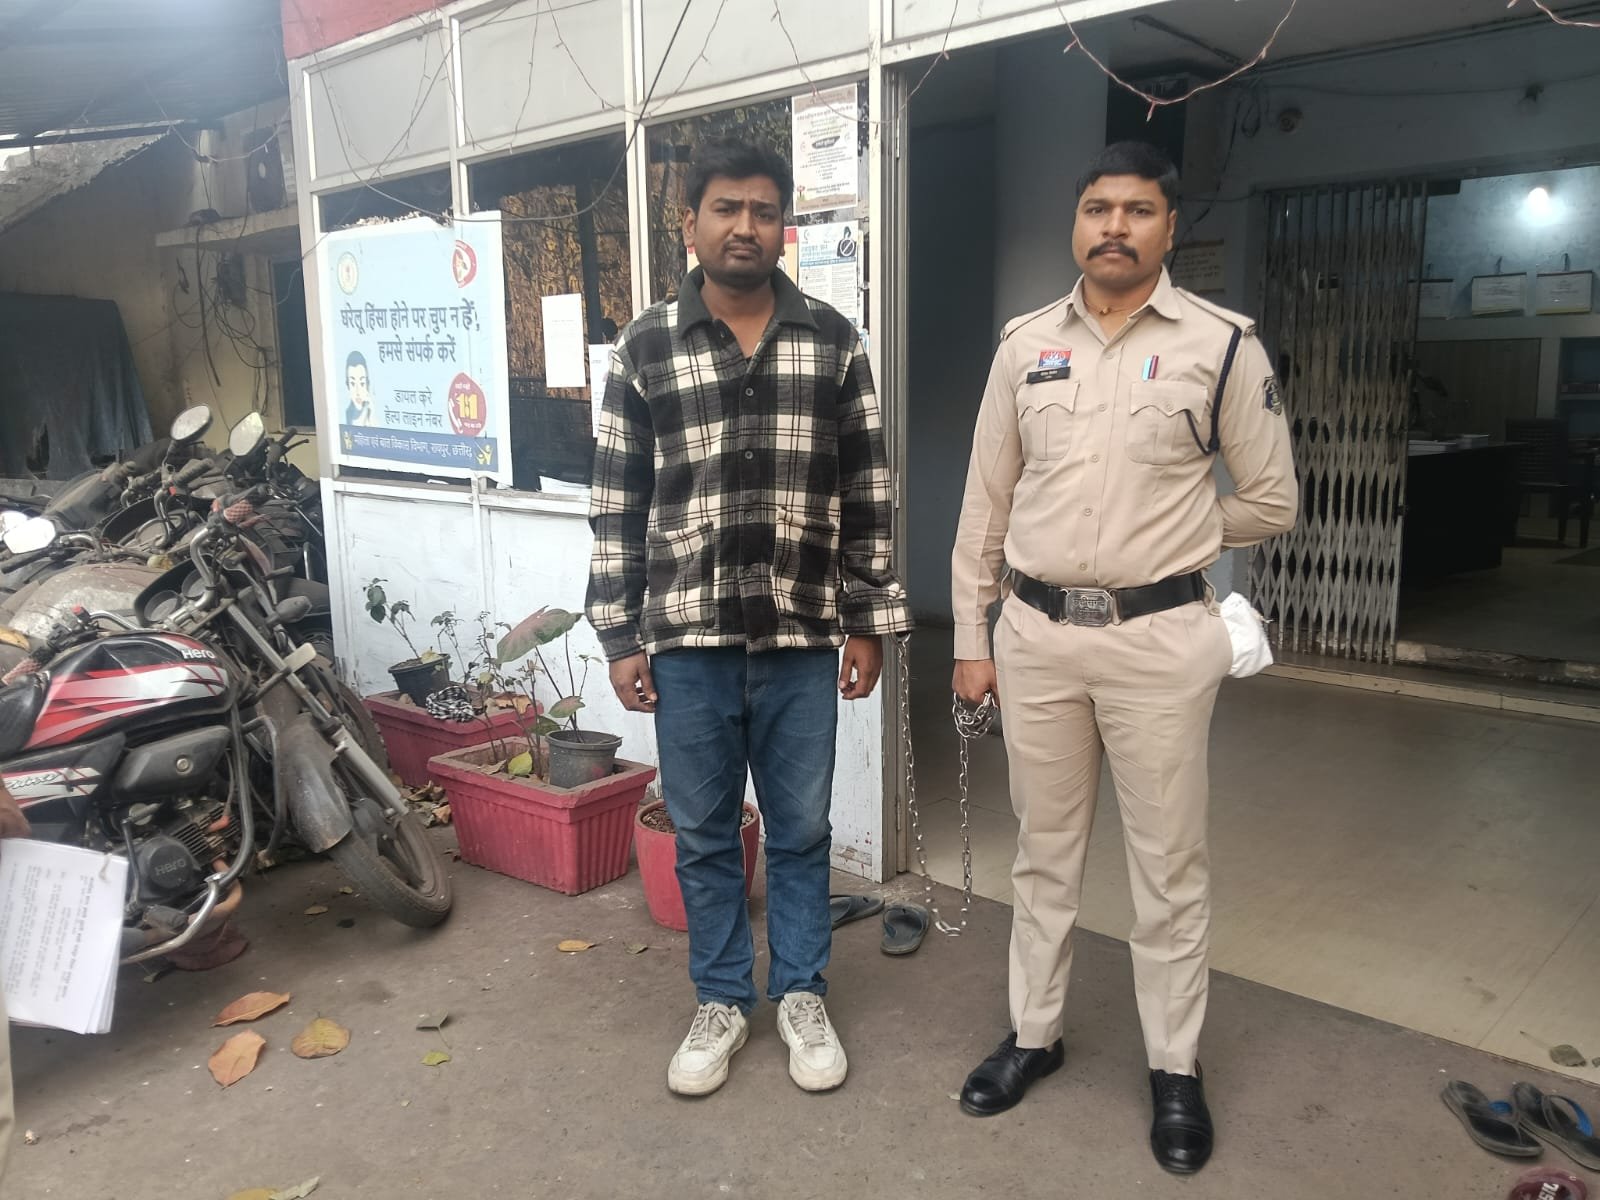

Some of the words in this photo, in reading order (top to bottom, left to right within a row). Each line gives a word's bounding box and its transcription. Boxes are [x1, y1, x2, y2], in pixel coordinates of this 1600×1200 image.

[340, 302, 365, 334] घरेलू
[389, 300, 409, 331] होने
[411, 307, 427, 329] पर
[428, 307, 448, 335] चुप
[377, 333, 403, 363] हमसे
[405, 333, 434, 363] संपर्क
[436, 333, 456, 362] करें
[181, 649, 216, 659] Hero
